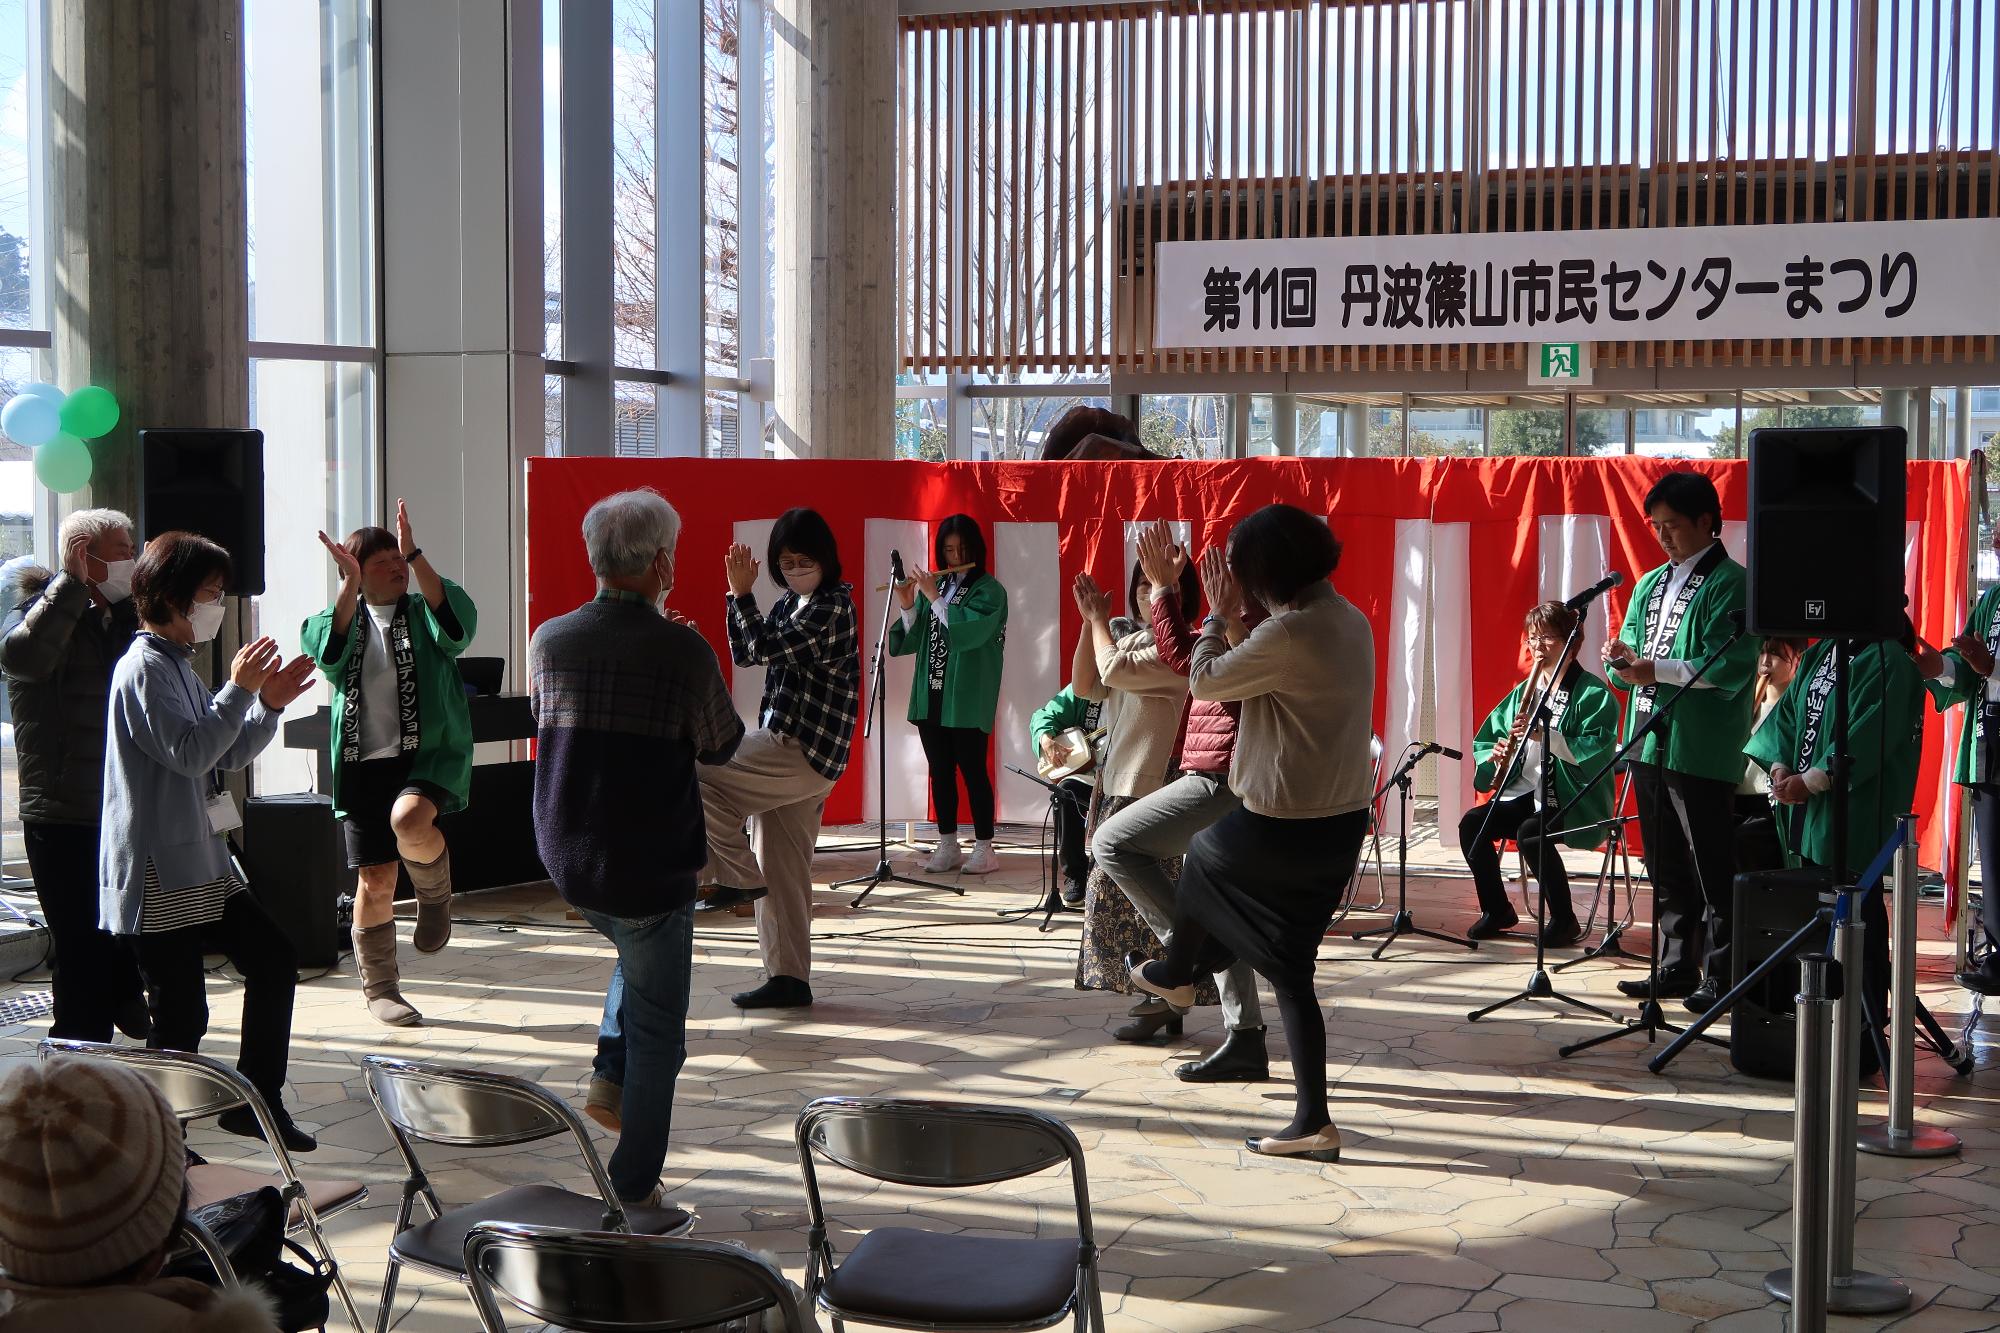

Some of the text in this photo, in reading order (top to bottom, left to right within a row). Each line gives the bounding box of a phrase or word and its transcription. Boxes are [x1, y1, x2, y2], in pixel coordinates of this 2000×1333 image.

[1203, 251, 1918, 332] 第11回 丹波篠山市民センターまつり
